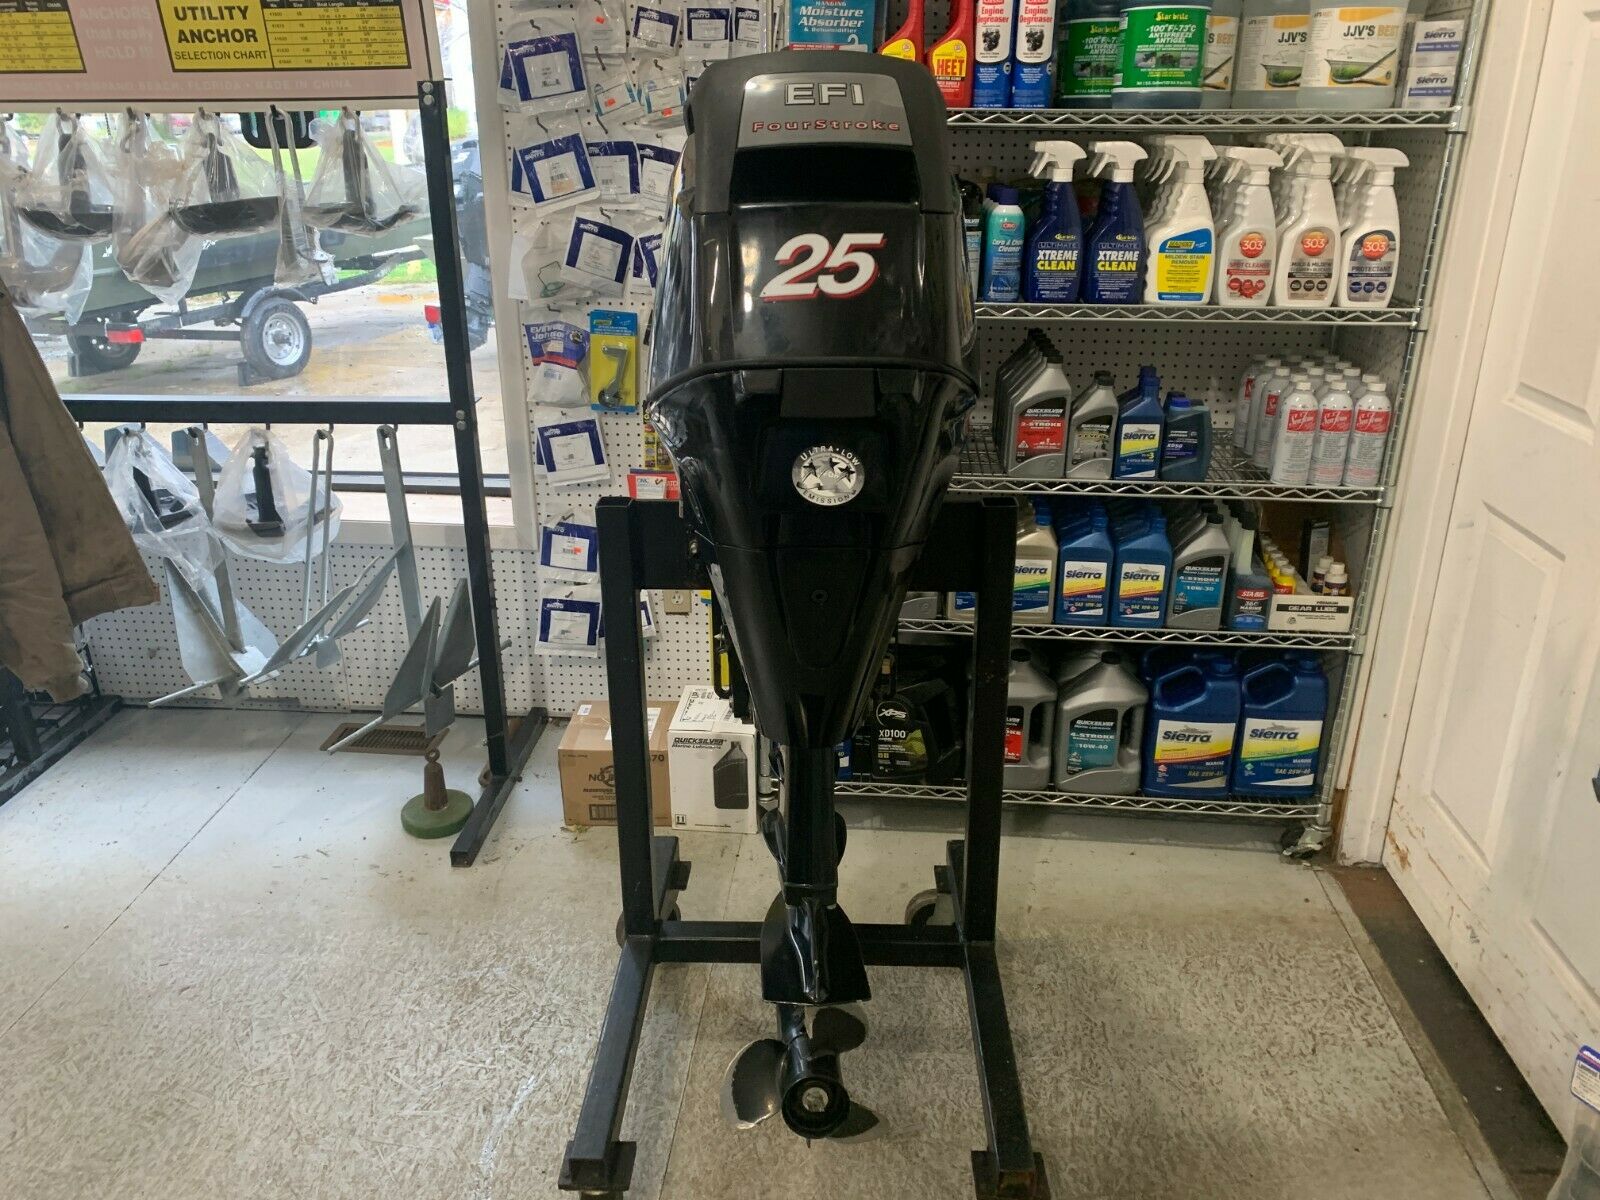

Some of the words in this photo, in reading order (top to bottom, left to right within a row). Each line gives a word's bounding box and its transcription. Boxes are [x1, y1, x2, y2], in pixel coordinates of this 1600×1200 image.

[173, 5, 249, 21] UTILITY
[799, 6, 864, 17] Moisture
[981, 6, 1004, 16] Engine
[1024, 6, 1048, 16] Engine
[798, 16, 865, 28] Absorber
[1020, 15, 1053, 25] Degreaser
[178, 28, 258, 44] ANCHOR
[1148, 31, 1194, 39] ANTIFREEZE
[1343, 25, 1377, 38] JJV'S
[1423, 31, 1457, 40] Sierra
[1277, 32, 1307, 44] JJV'S
[95, 46, 135, 59] HOLD
[174, 50, 231, 60] SELECTION
[233, 50, 267, 60] CHART
[936, 58, 965, 76] HEET
[313, 78, 352, 90] CHINA
[1416, 76, 1449, 85] Sierra
[784, 82, 865, 106] EFI
[752, 119, 901, 133] FourStroke
[998, 245, 1022, 253] Cleaner
[1038, 242, 1079, 250] ULTIMATE
[1241, 240, 1263, 250] 303
[1303, 239, 1326, 249] 303
[1363, 241, 1387, 252] 303
[1037, 250, 1079, 261] XTREME
[1097, 251, 1140, 261] XTREME
[759, 232, 888, 303] 25
[1036, 261, 1076, 271] CLEAN
[1097, 262, 1137, 271] CLEAN
[1123, 431, 1157, 440] Sierra
[800, 445, 834, 461] ULTRA
[840, 448, 860, 466] LOW
[802, 488, 857, 504] EMISSIONS
[1065, 570, 1103, 579] Sierra
[1122, 571, 1160, 581] Sierra
[1075, 719, 1115, 727] QUICKSILVER
[878, 728, 906, 739] XD100
[1162, 730, 1212, 743] Sierra
[1249, 728, 1300, 740] Sierra
[673, 737, 725, 746] QUICKSILVER
